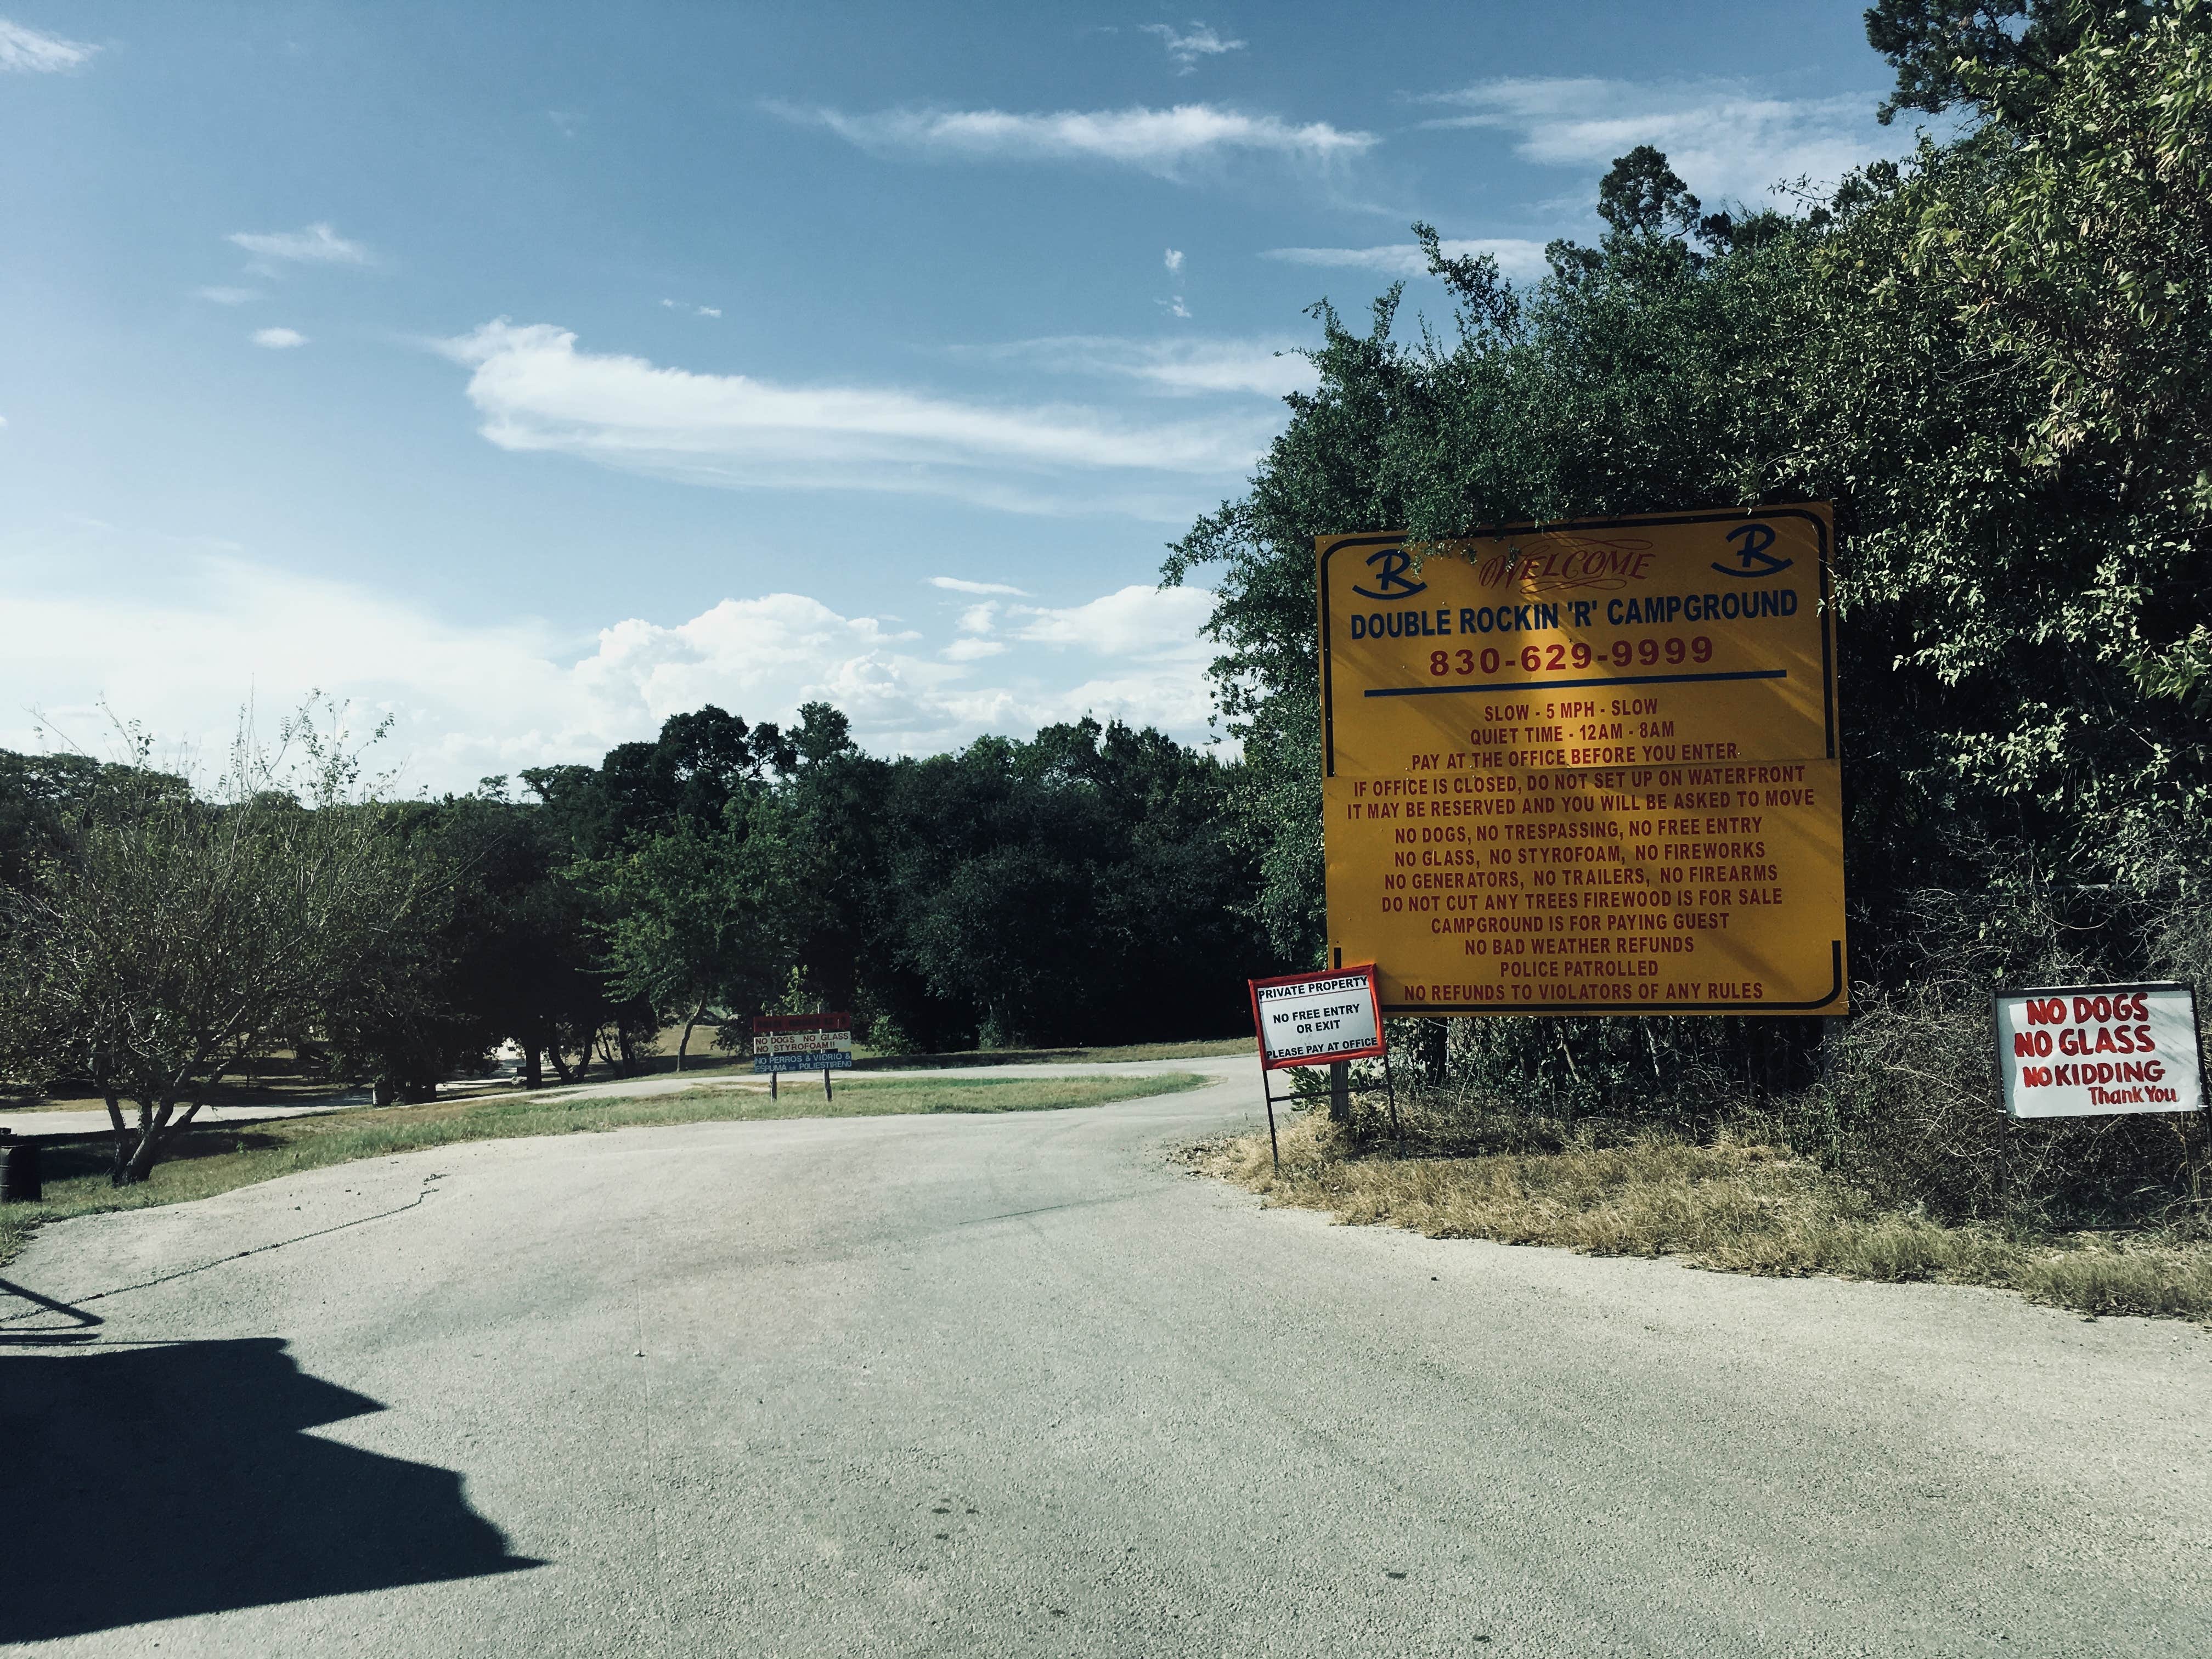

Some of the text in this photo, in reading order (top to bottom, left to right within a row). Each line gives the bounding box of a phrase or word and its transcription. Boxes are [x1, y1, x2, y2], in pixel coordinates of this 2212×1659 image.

[1479, 545, 1656, 589] WELCOME
[1351, 589, 1797, 640] DOUBLE ROCKIN 'R' CAMPGROUND
[1430, 636, 1712, 676] 830-629-9999
[1485, 704, 1529, 721] SLOW
[1547, 703, 1554, 719] 5
[1561, 701, 1594, 718] MPH
[1612, 698, 1657, 716] SLOW
[1471, 728, 1519, 746] QUIET
[1525, 726, 1562, 743] TIME
[1580, 723, 1622, 740] 12AM
[1640, 721, 1674, 738] 8AM
[1412, 743, 1737, 770] PAY AT THE OFFICE BEFORE YOU ENTER
[1355, 765, 1805, 797] IF OFFICE IS CLOSED, DO NOT SET UP ON WATERFRONT
[1348, 789, 1814, 819] IT MAY BE RESERVED AND YOU WILL BE ASKED TO MOVE
[1396, 817, 1762, 845] NO DOGS, NO TRESPASSING, NO FREE ENTRY
[1395, 842, 1765, 868] NO GLASS, NO STYROFOAM, NO FIREWORKS
[1385, 865, 1777, 890] NO GENERATORS, NO TRAILERS, NO FIREARMS
[1383, 888, 1782, 912] DO NOT CUT ANY TREES FIREWOOD IS FOR SALE
[1432, 913, 1729, 934] CAMPGROUND IS FOR PAYING GUEST
[1465, 936, 1694, 955] NO BAD WEATHER REFUNDS
[1501, 961, 1658, 977] POLICE PATROLLED
[1259, 977, 1368, 1000] PRIVATE PROPERTY
[1405, 983, 1763, 1001] NO REFUNDS TO VIOLATORS OF ANY RULES
[1273, 1003, 1360, 1024] NO FREE ENTRY
[2026, 992, 2149, 1025] NO DOGS
[821, 1032, 849, 1041] GLASS
[1296, 1020, 1340, 1034] OR EXIT
[1267, 1037, 1378, 1059] PLEASE PAY AT OFFICE
[2014, 1025, 2155, 1058] NO GLASS
[755, 1064, 787, 1073] ESPUMA
[799, 1060, 851, 1070] POLIESTIRENO
[769, 1055, 802, 1064] PERROS
[813, 1053, 842, 1061] VIDRIO
[2023, 1060, 2165, 1087] NO KIDDING
[2088, 1085, 2177, 1105] Thank You
